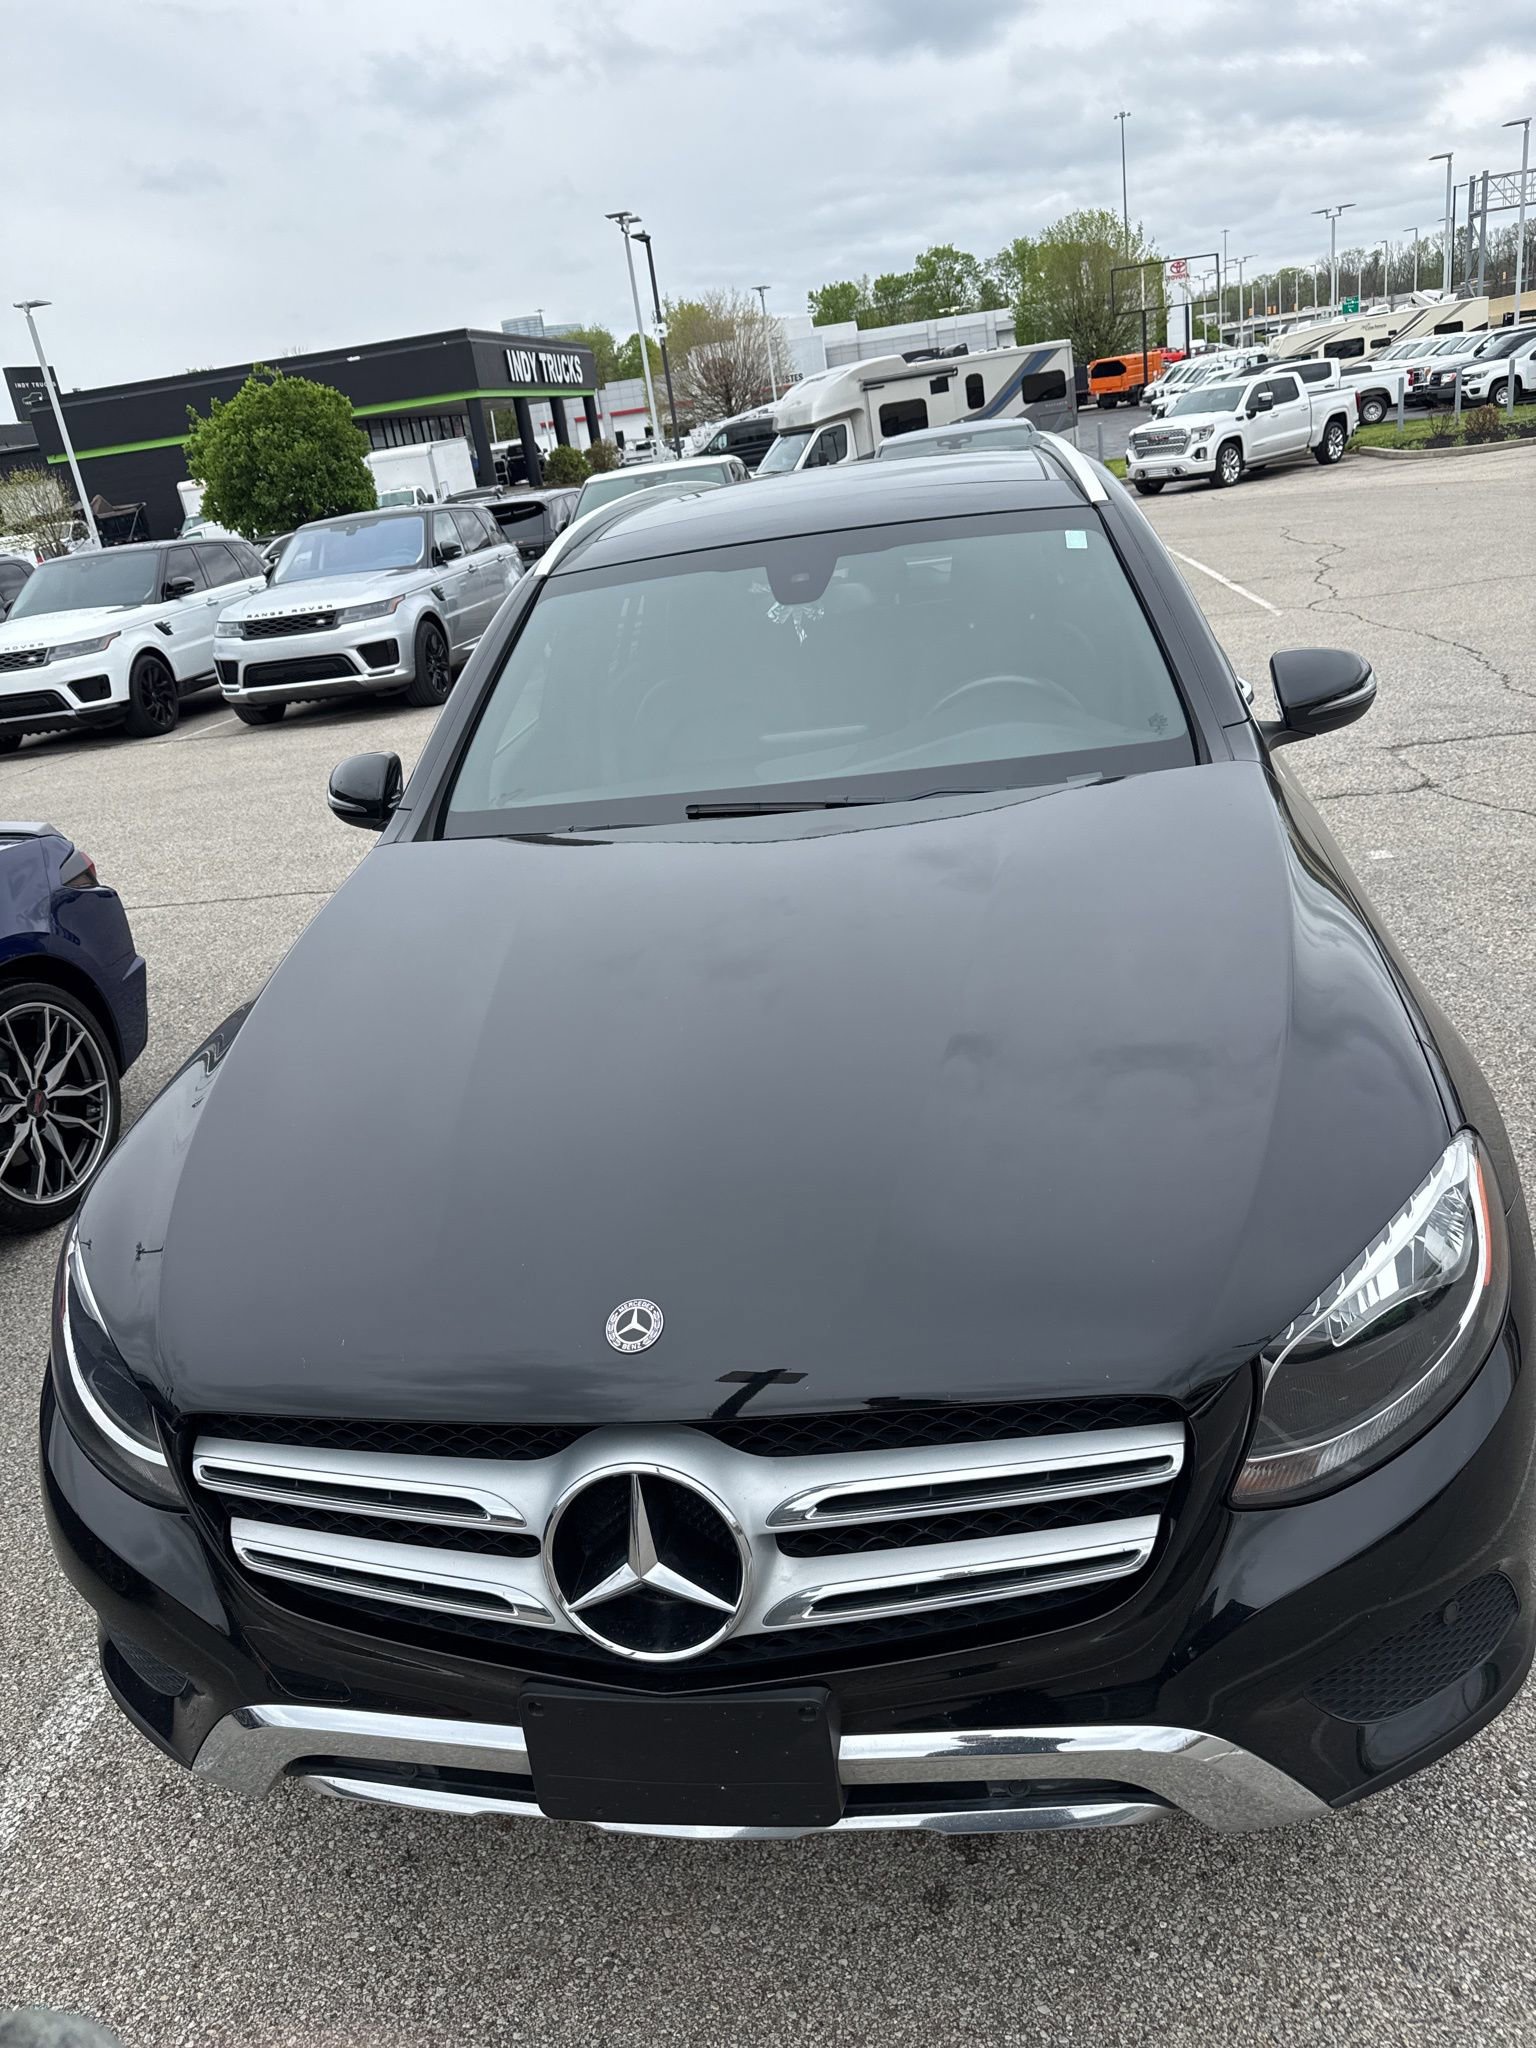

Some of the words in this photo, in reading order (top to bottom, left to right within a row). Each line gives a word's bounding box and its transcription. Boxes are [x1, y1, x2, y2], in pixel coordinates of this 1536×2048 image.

[506, 349, 538, 383] INDY
[538, 352, 583, 384] TRUCKS
[246, 610, 284, 619] RANGE
[291, 604, 333, 613] ROVER
[4, 642, 44, 651] ROVER
[618, 1300, 655, 1313] MERCEDES
[621, 1342, 643, 1351] BENZ
